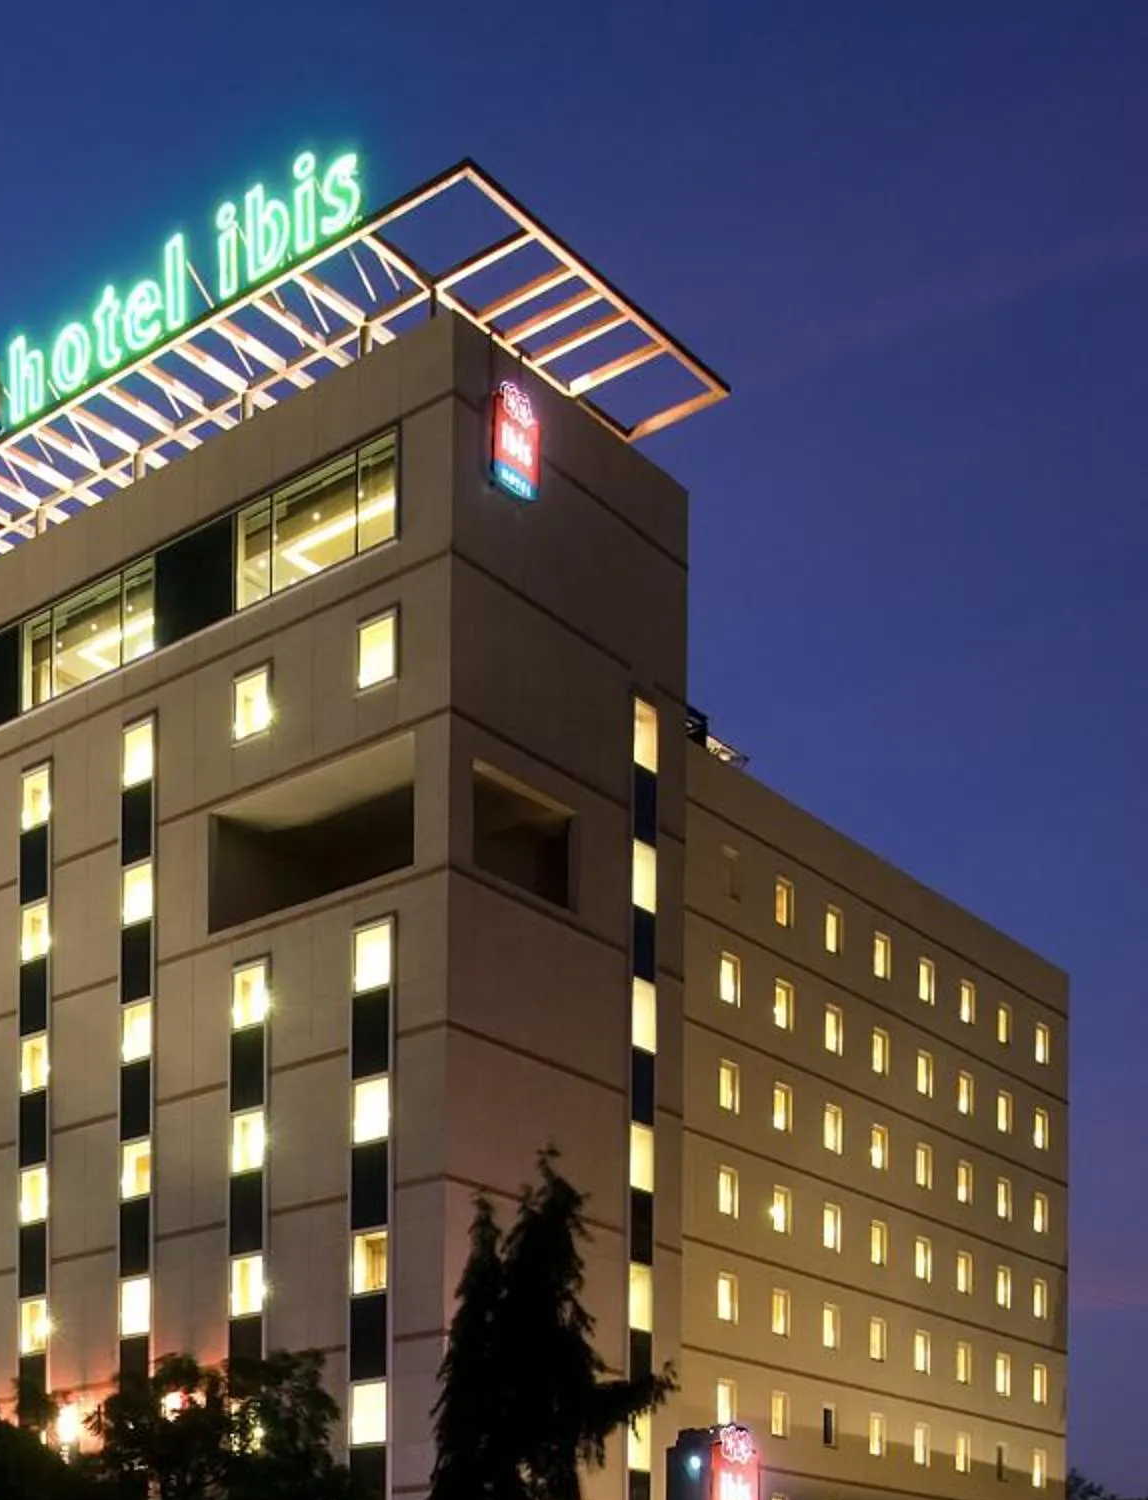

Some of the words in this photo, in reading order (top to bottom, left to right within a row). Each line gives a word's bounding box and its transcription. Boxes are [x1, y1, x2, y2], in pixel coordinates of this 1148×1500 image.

[7, 232, 187, 426] hotel
[215, 151, 362, 300] ibis
[500, 420, 533, 468] ibis
